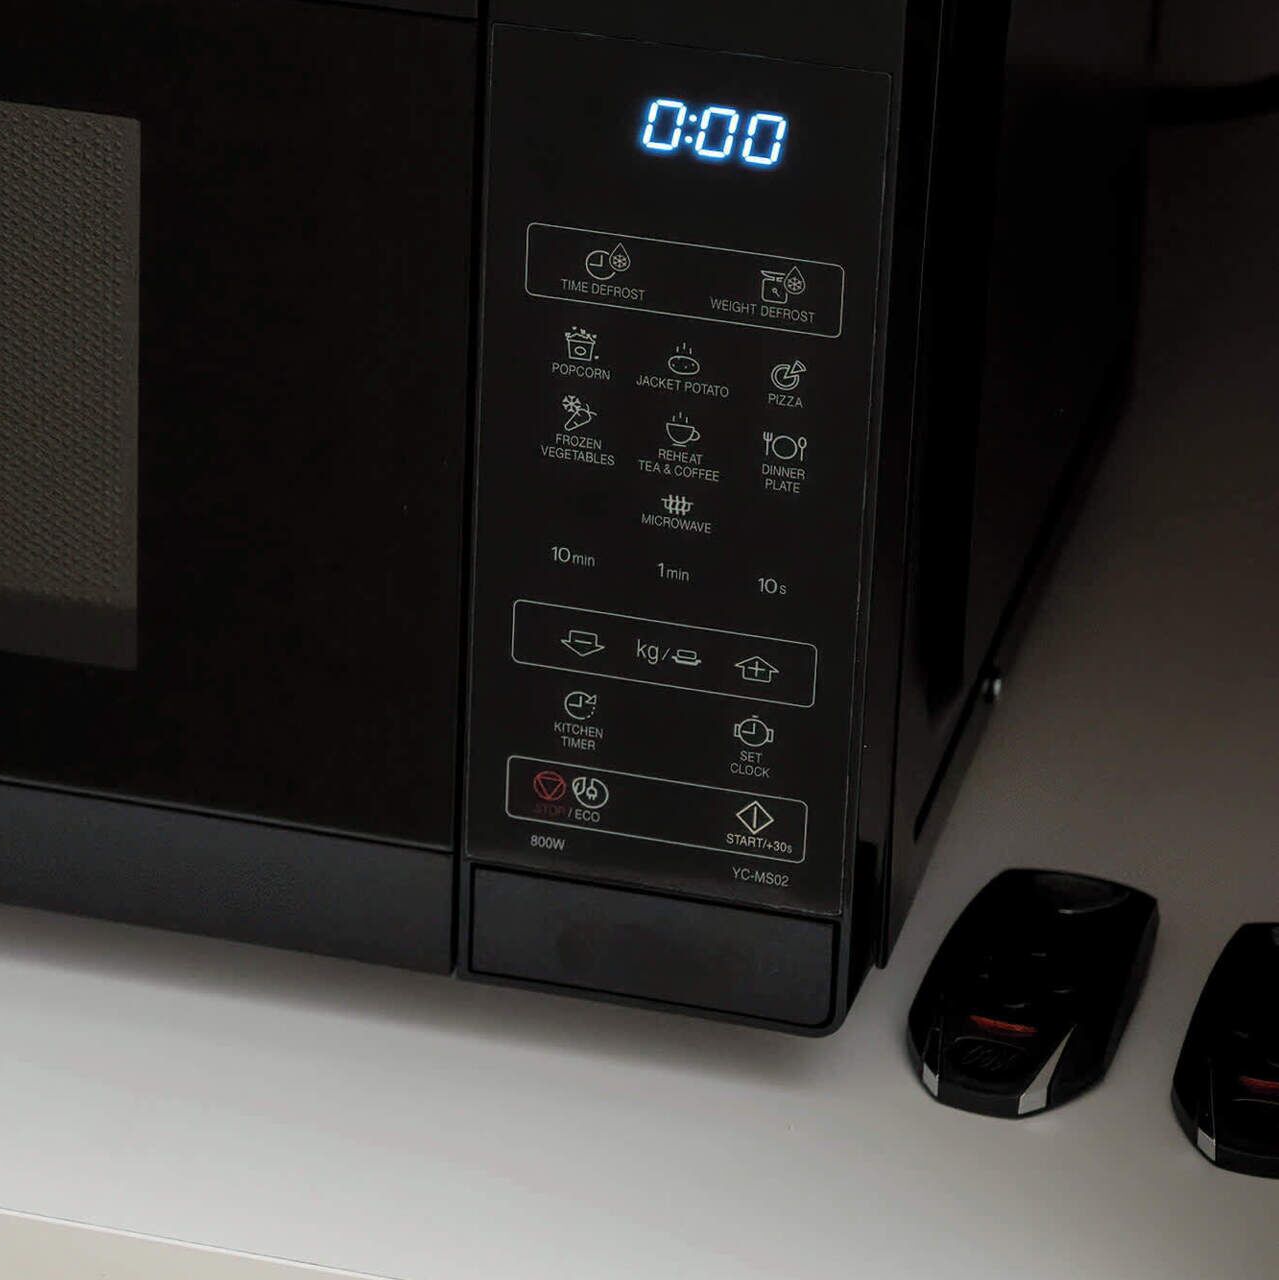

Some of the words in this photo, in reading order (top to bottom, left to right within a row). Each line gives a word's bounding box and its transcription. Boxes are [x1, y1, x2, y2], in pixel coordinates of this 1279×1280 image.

[642, 99, 786, 165] 0:00
[561, 279, 589, 293] TIME
[592, 283, 645, 301] DEFROST
[710, 297, 757, 315] WEIGHT
[760, 305, 816, 323] DEFROST
[552, 362, 611, 381] POPCORN
[636, 375, 681, 392] JACKET
[684, 382, 729, 398] POTATO
[768, 393, 803, 408] PIZZA
[555, 433, 602, 450] FROZEN
[541, 445, 615, 466] VEGETABLES
[658, 448, 704, 465] REHEAT
[638, 459, 662, 473] TEA
[664, 463, 671, 475] &
[674, 465, 720, 482] COFFEE
[761, 464, 805, 480] DINNER
[765, 479, 801, 494] PLATE
[641, 513, 712, 534] MICROWAVE
[553, 721, 603, 740] KITCHEN
[561, 735, 596, 751] TIMER
[740, 751, 762, 764] SET
[730, 762, 771, 778] CLOCK
[530, 834, 565, 851] 800W
[732, 867, 790, 888] YC-MS02
